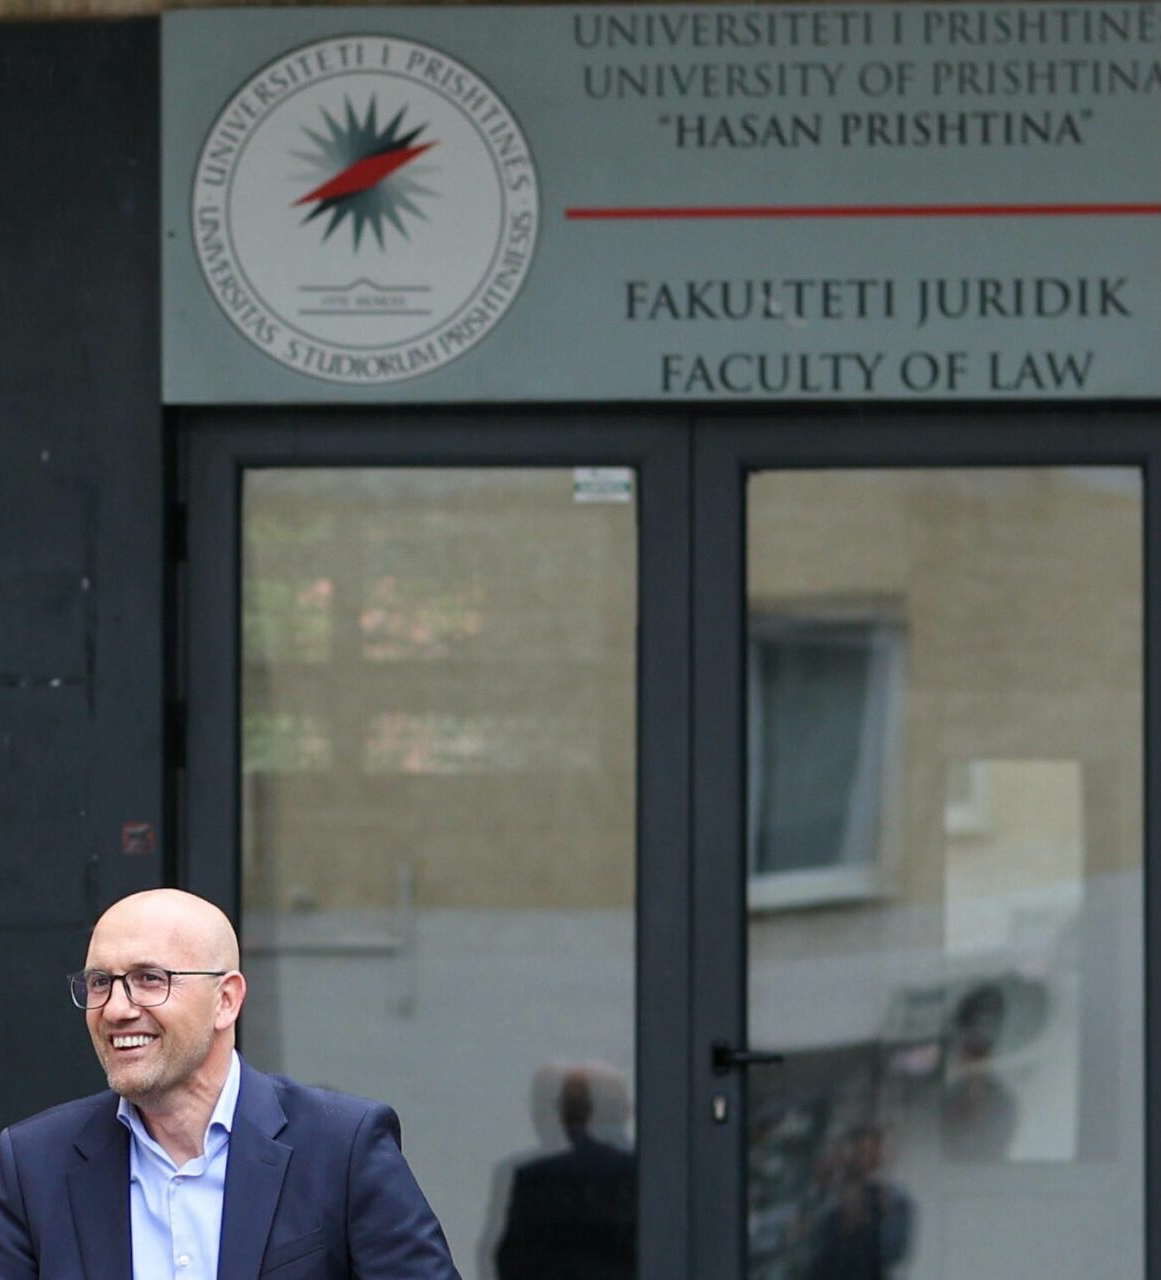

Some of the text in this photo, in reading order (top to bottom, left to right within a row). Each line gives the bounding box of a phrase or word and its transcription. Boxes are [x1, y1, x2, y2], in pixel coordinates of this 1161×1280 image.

[572, 4, 1161, 48] UNIVERSITETI I PRISHTINË
[583, 59, 1161, 100] UNIVERSITY OF PRISHTINA
[203, 43, 364, 190] UNIVERSITETI
[381, 44, 389, 68] I
[197, 206, 283, 345] UNIVERSITAS
[285, 341, 440, 378] STUDIORUM
[625, 277, 1132, 326] FAKULTETI JURIDIK
[659, 351, 1094, 393] FACULTY OF LAW
